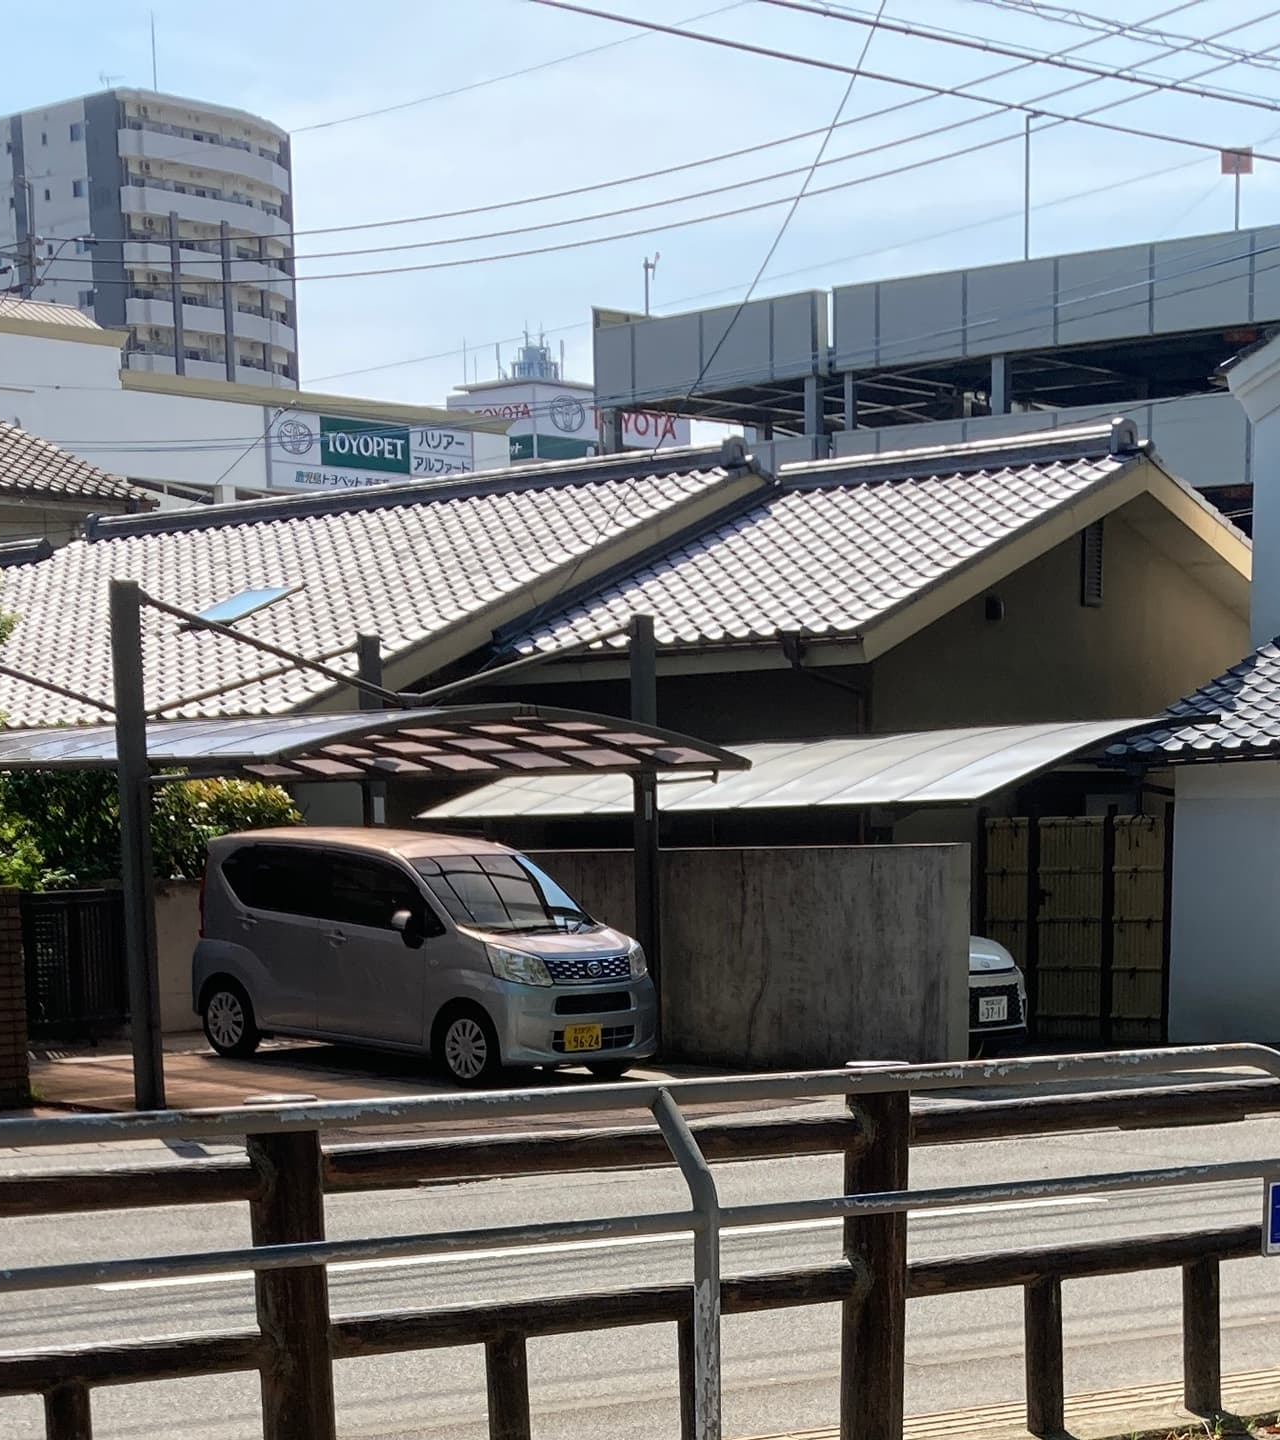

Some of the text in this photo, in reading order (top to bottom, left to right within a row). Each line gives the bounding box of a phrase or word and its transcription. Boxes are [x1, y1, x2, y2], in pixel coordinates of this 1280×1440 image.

[588, 406, 677, 440] TYOTA
[328, 432, 405, 460] TOYOPET
[419, 431, 465, 450] ハリアー
